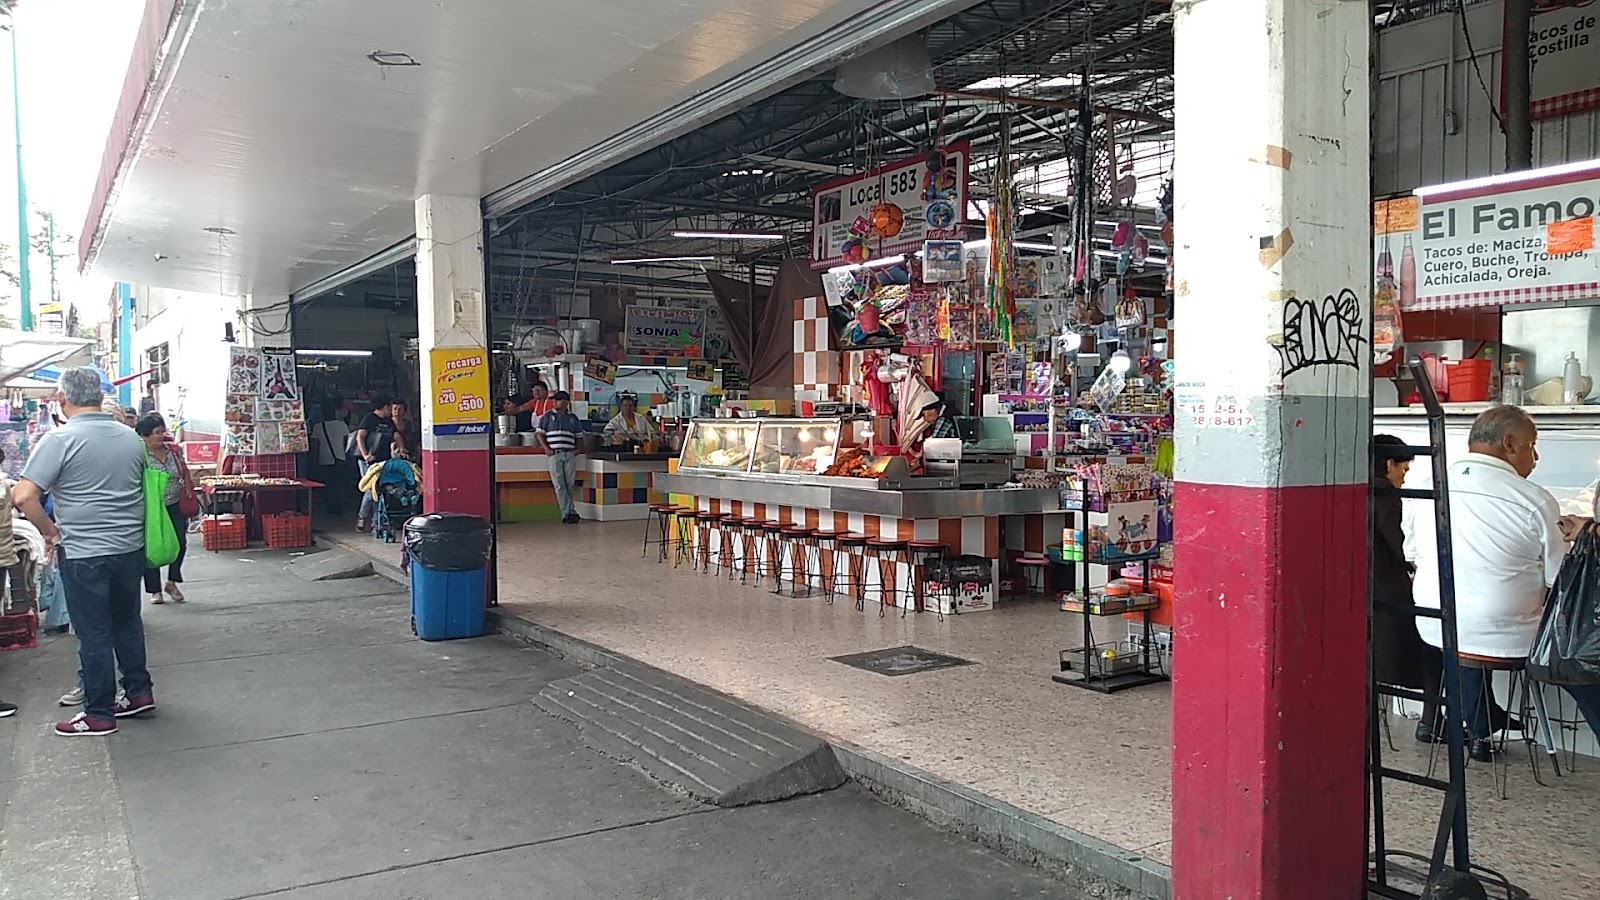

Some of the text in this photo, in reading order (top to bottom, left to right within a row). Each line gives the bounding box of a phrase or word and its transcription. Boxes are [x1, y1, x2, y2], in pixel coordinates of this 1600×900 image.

[1529, 16, 1596, 43] acos de
[850, 168, 918, 207] Local 583
[1423, 207, 1456, 241] El
[1473, 196, 1600, 235] Famo
[1424, 246, 1462, 259] Tacos
[1467, 242, 1488, 255] de:
[1493, 236, 1546, 252] Maciza,
[1424, 259, 1467, 273] Cuero,
[1472, 254, 1519, 268] Buche,
[1424, 264, 1551, 287] Achicalada, Oreja.
[447, 357, 482, 370] recarga
[439, 392, 483, 411] $20 $500
[465, 425, 485, 434] telcel
